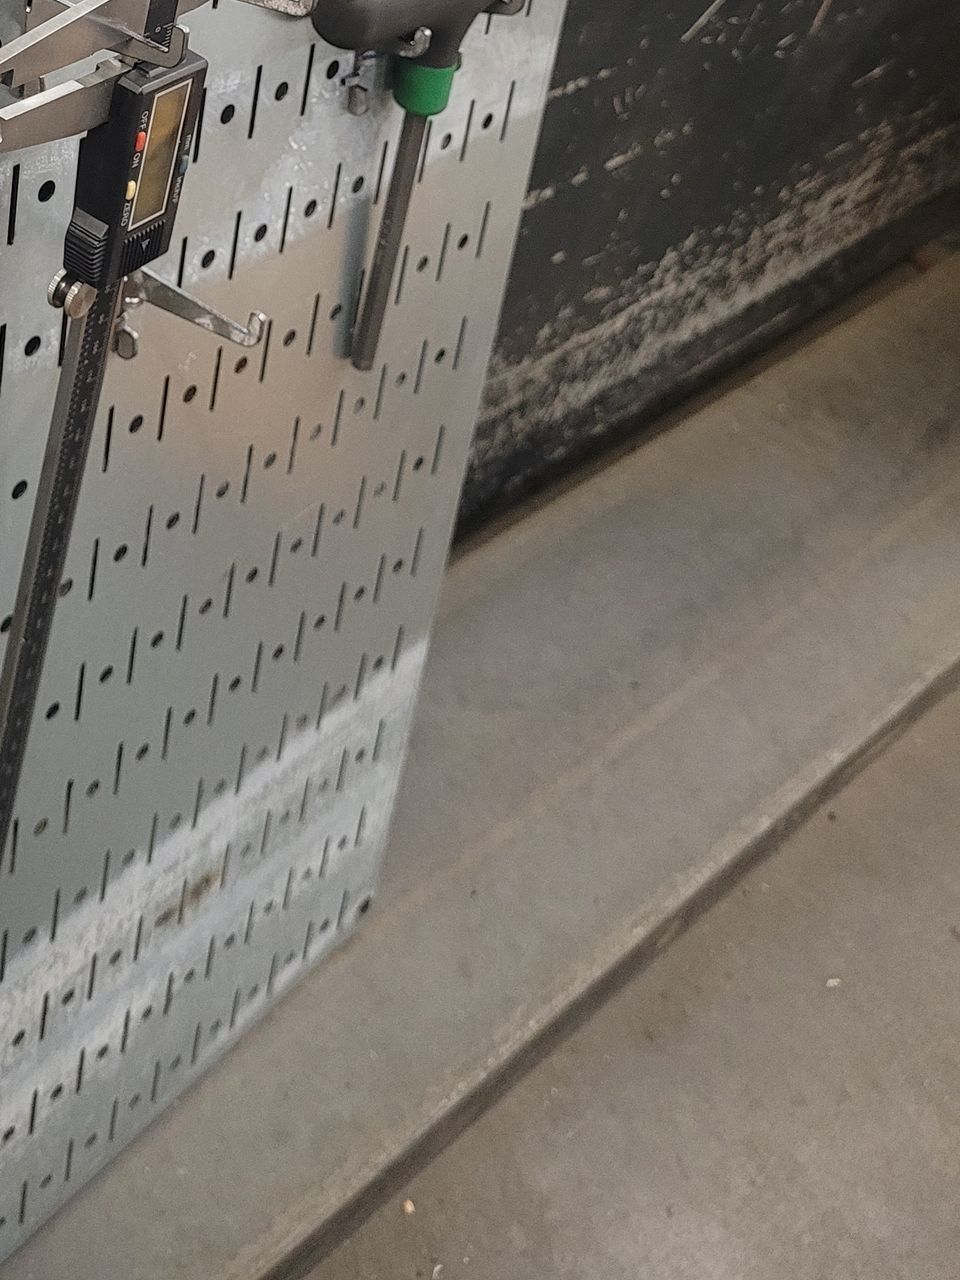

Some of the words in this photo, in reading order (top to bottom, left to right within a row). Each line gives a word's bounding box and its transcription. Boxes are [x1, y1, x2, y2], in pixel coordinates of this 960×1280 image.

[140, 111, 149, 130] OFF
[132, 153, 141, 169] ON
[121, 202, 132, 227] ZERO
